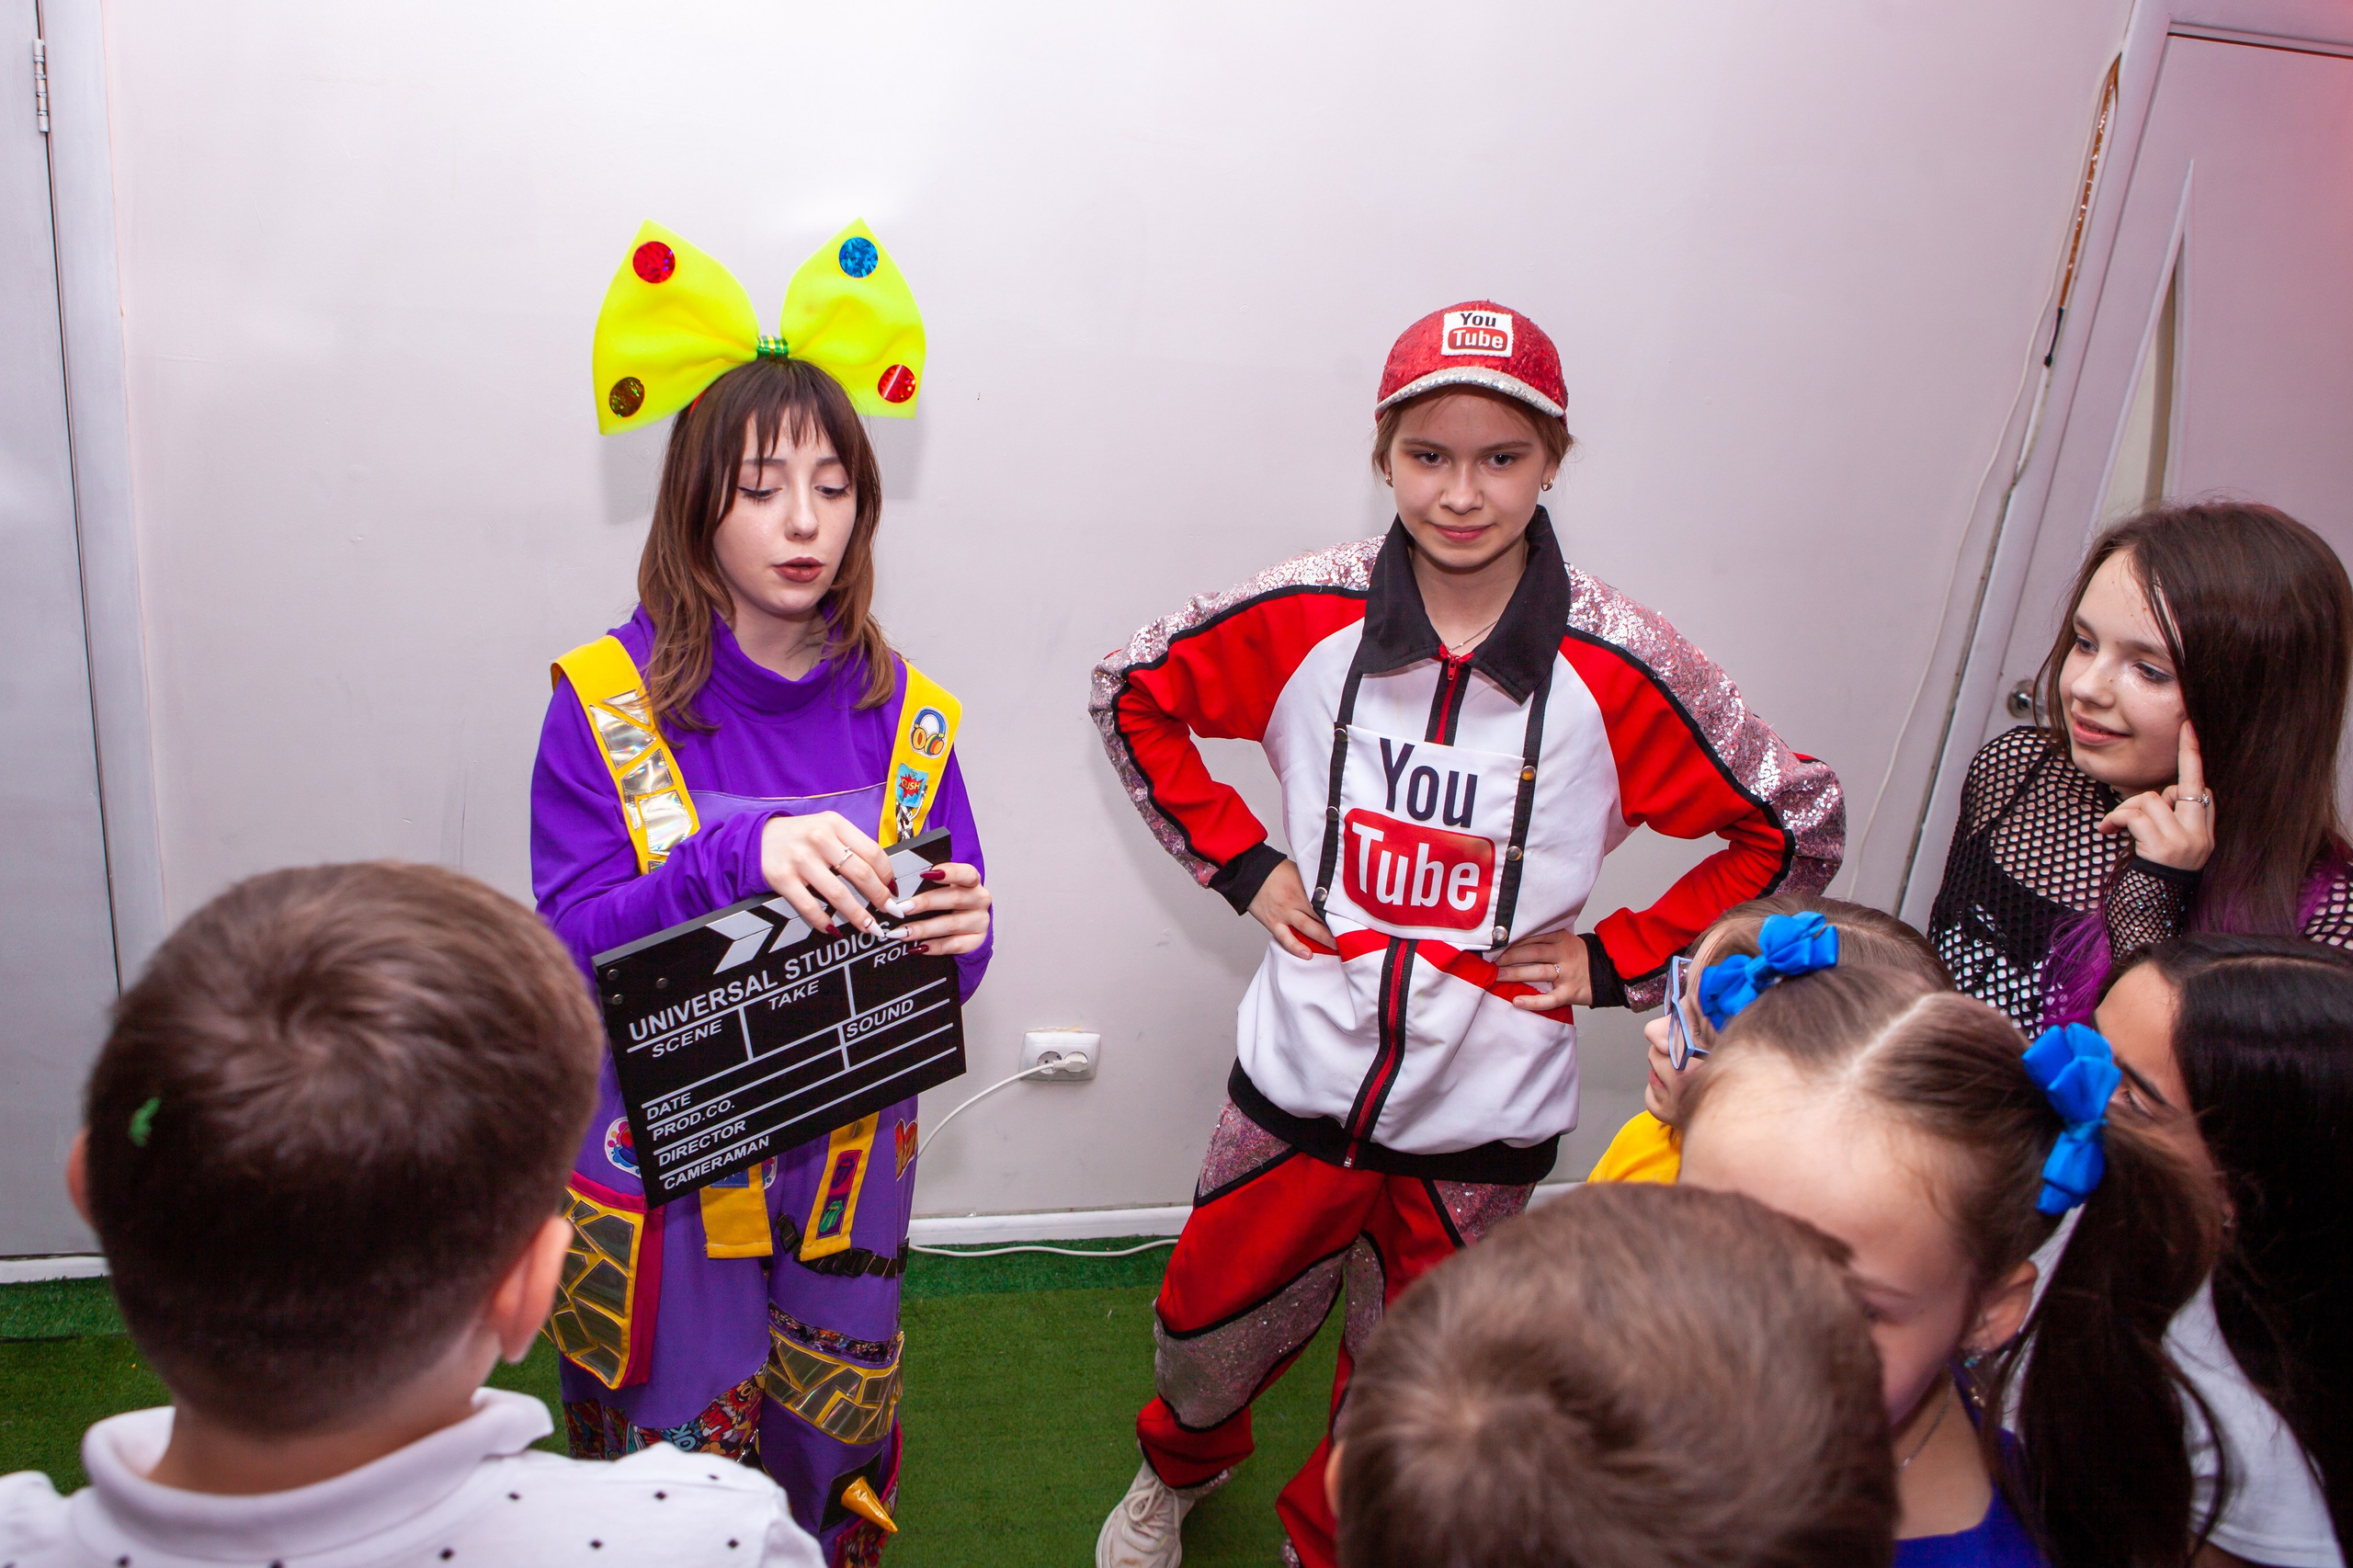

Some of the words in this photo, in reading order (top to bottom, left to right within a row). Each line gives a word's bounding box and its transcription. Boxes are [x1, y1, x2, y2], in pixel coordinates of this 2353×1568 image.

[1453, 330, 1504, 349] Tube
[1461, 312, 1496, 327] You
[1380, 737, 1478, 828] You
[1352, 822, 1480, 911] Tube
[630, 970, 778, 1041] UNIVERSAL
[768, 980, 820, 1010] TAKE
[652, 1019, 722, 1058] SCENE
[847, 998, 914, 1038] SOUND
[646, 1092, 691, 1120] DATE
[653, 1099, 735, 1142] PROD.CO.
[658, 1120, 746, 1166] DIRECTOR
[664, 1136, 769, 1190] CAMERAMAN
